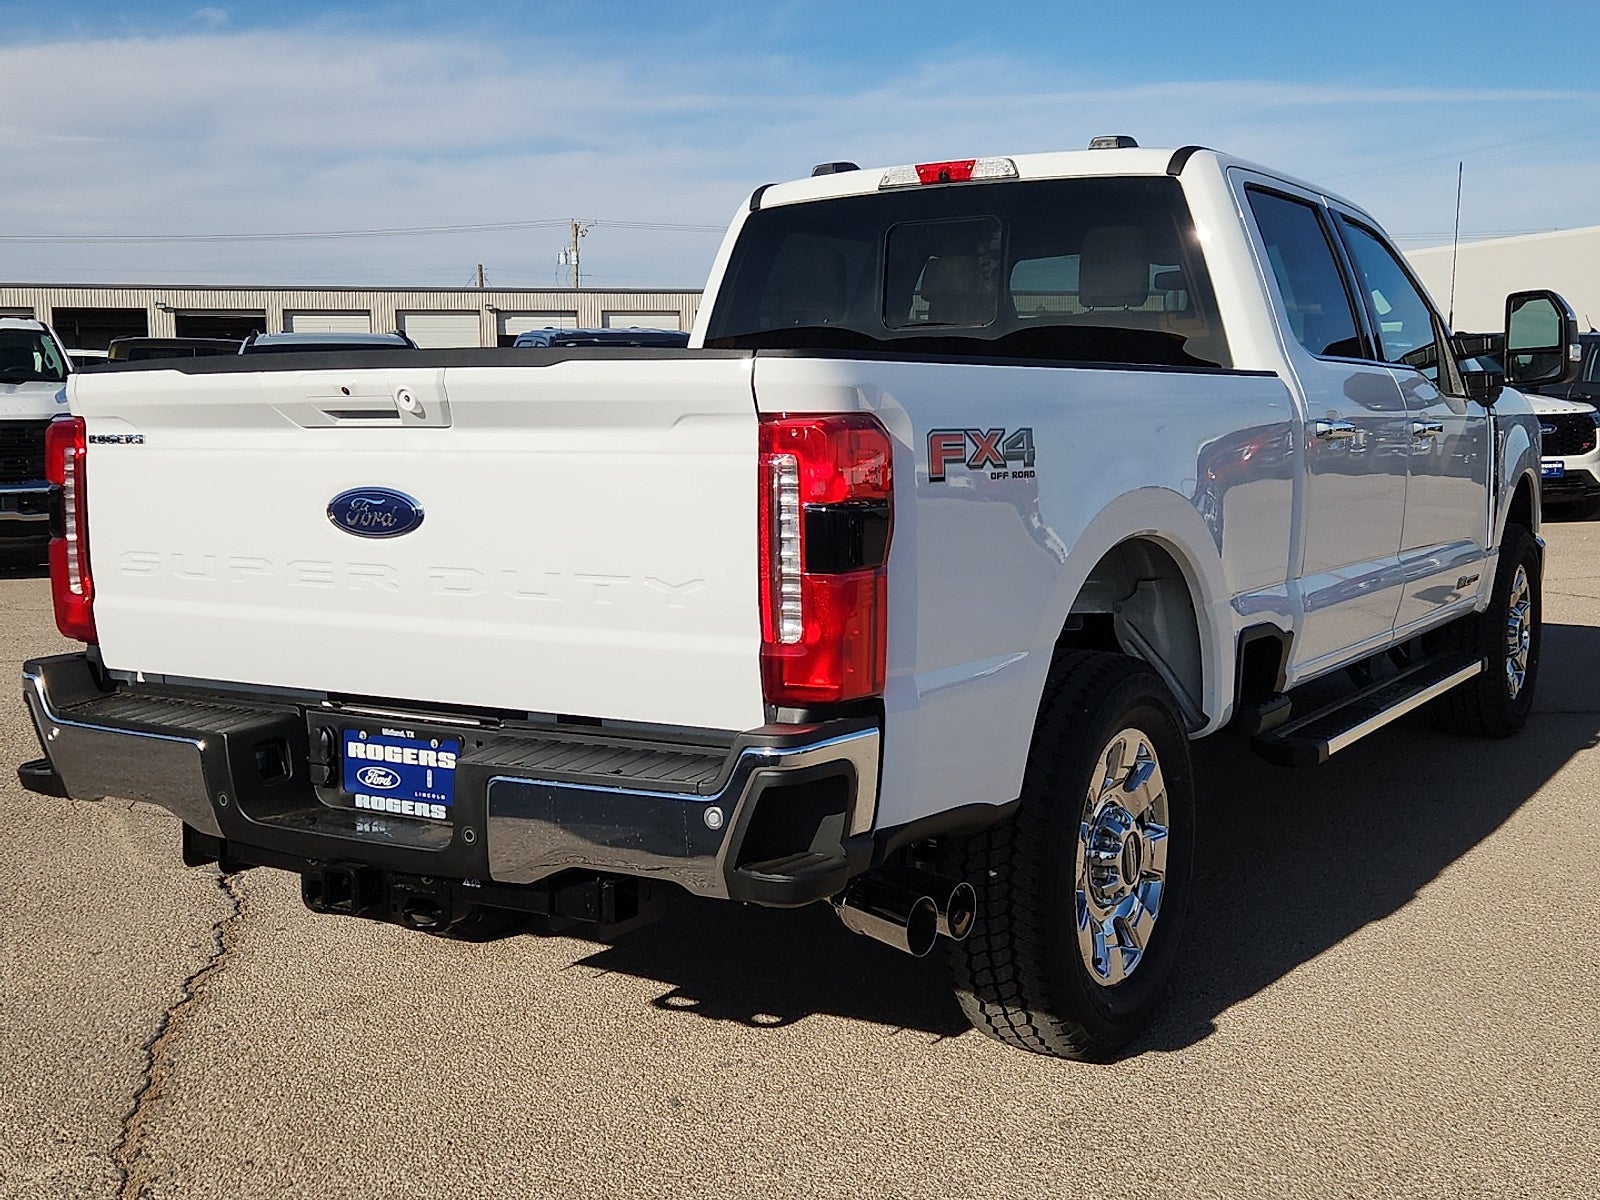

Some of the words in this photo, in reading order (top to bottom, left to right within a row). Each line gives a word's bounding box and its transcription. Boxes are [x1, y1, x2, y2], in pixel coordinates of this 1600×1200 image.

[927, 428, 1036, 482] FX4
[990, 470, 1010, 480] OFF
[1012, 469, 1036, 479] ROAD
[346, 493, 398, 527] Ford
[119, 550, 399, 594] SUPER
[428, 565, 707, 610] DUTY
[347, 741, 457, 769] ROGERS
[364, 768, 393, 786] Ford
[354, 793, 447, 820] ROGERS
[414, 790, 446, 800] LINCOLN
